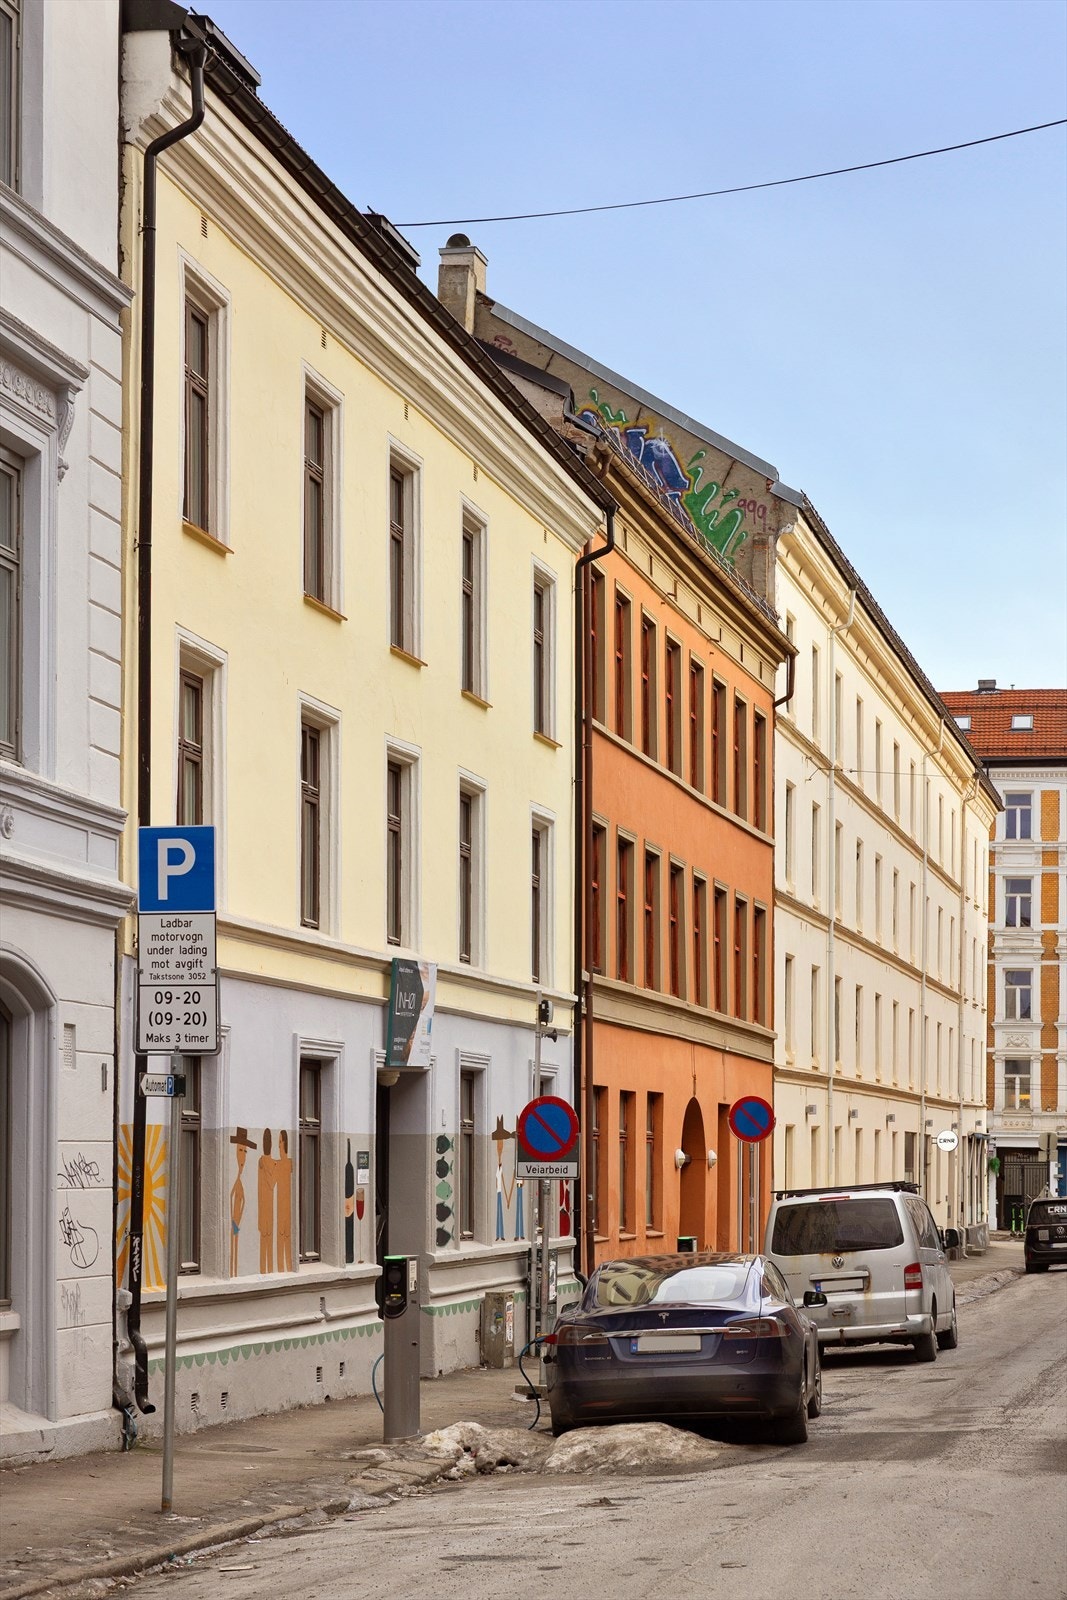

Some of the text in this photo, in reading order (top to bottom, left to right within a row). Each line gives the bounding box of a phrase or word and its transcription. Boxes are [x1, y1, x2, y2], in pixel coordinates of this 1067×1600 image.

[157, 838, 196, 901] P
[160, 918, 193, 928] Ladbar
[151, 932, 203, 944] motorvogn
[147, 945, 207, 958] under lading
[152, 958, 203, 971] mot avgift
[149, 973, 206, 981] Takstsone 3052
[146, 1033, 209, 1043] Maks 3 timer
[145, 1078, 167, 1092] Automat
[526, 1165, 568, 1175] Veiarbeid
